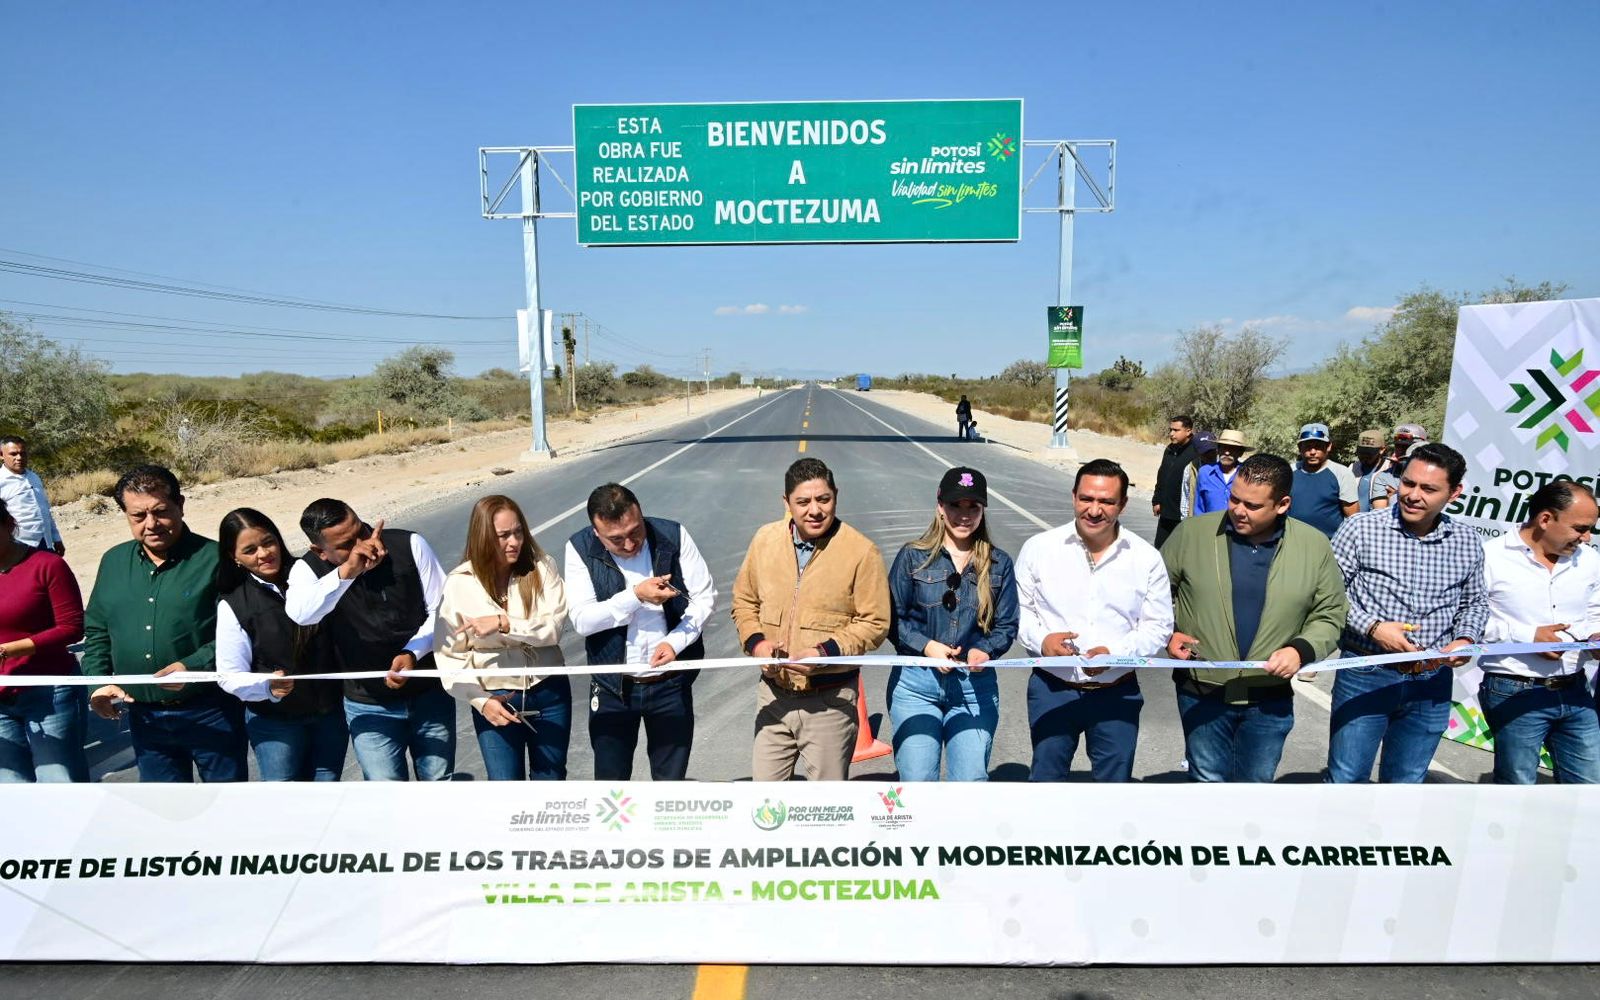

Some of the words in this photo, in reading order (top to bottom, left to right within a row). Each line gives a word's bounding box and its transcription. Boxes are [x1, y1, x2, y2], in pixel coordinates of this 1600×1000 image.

[618, 117, 662, 134] ESTA
[707, 119, 887, 147] BIENVENIDOS
[599, 142, 645, 159] OBRA
[650, 141, 682, 158] FUE
[931, 142, 982, 157] POTOSÍ
[593, 166, 690, 183] REALIZADA
[788, 160, 806, 185] A
[890, 157, 918, 175] sin
[892, 178, 938, 199] Vialidad
[580, 191, 614, 208] POR
[620, 190, 703, 207] GOBIERNO
[714, 198, 881, 225] MOCTEZUMA
[590, 215, 623, 231] DEL
[628, 214, 694, 231] ESTADO
[654, 799, 733, 813] SEDUVOP
[788, 805, 807, 813] POR
[808, 805, 822, 813] UN
[822, 805, 853, 813] MEJOR
[510, 810, 535, 825] sin
[787, 812, 855, 822] MOCTEZUMA
[78, 857, 116, 878] DE
[123, 851, 223, 877] LISTÓN
[230, 852, 394, 875] INAUGURAL
[402, 852, 440, 872] DE
[448, 851, 504, 871] LOS
[511, 849, 665, 871] TRABAJOS
[672, 848, 711, 869] DE
[718, 841, 902, 869] AMPLIACIÓN
[909, 846, 930, 867] Y
[938, 840, 1183, 867] MODERNIZACIÓN
[1191, 845, 1230, 866] DE
[1238, 846, 1276, 866] LA
[1281, 845, 1452, 867] CARRETERA
[618, 881, 725, 902] ARISTA
[751, 879, 940, 901] MOCTEZUMA
